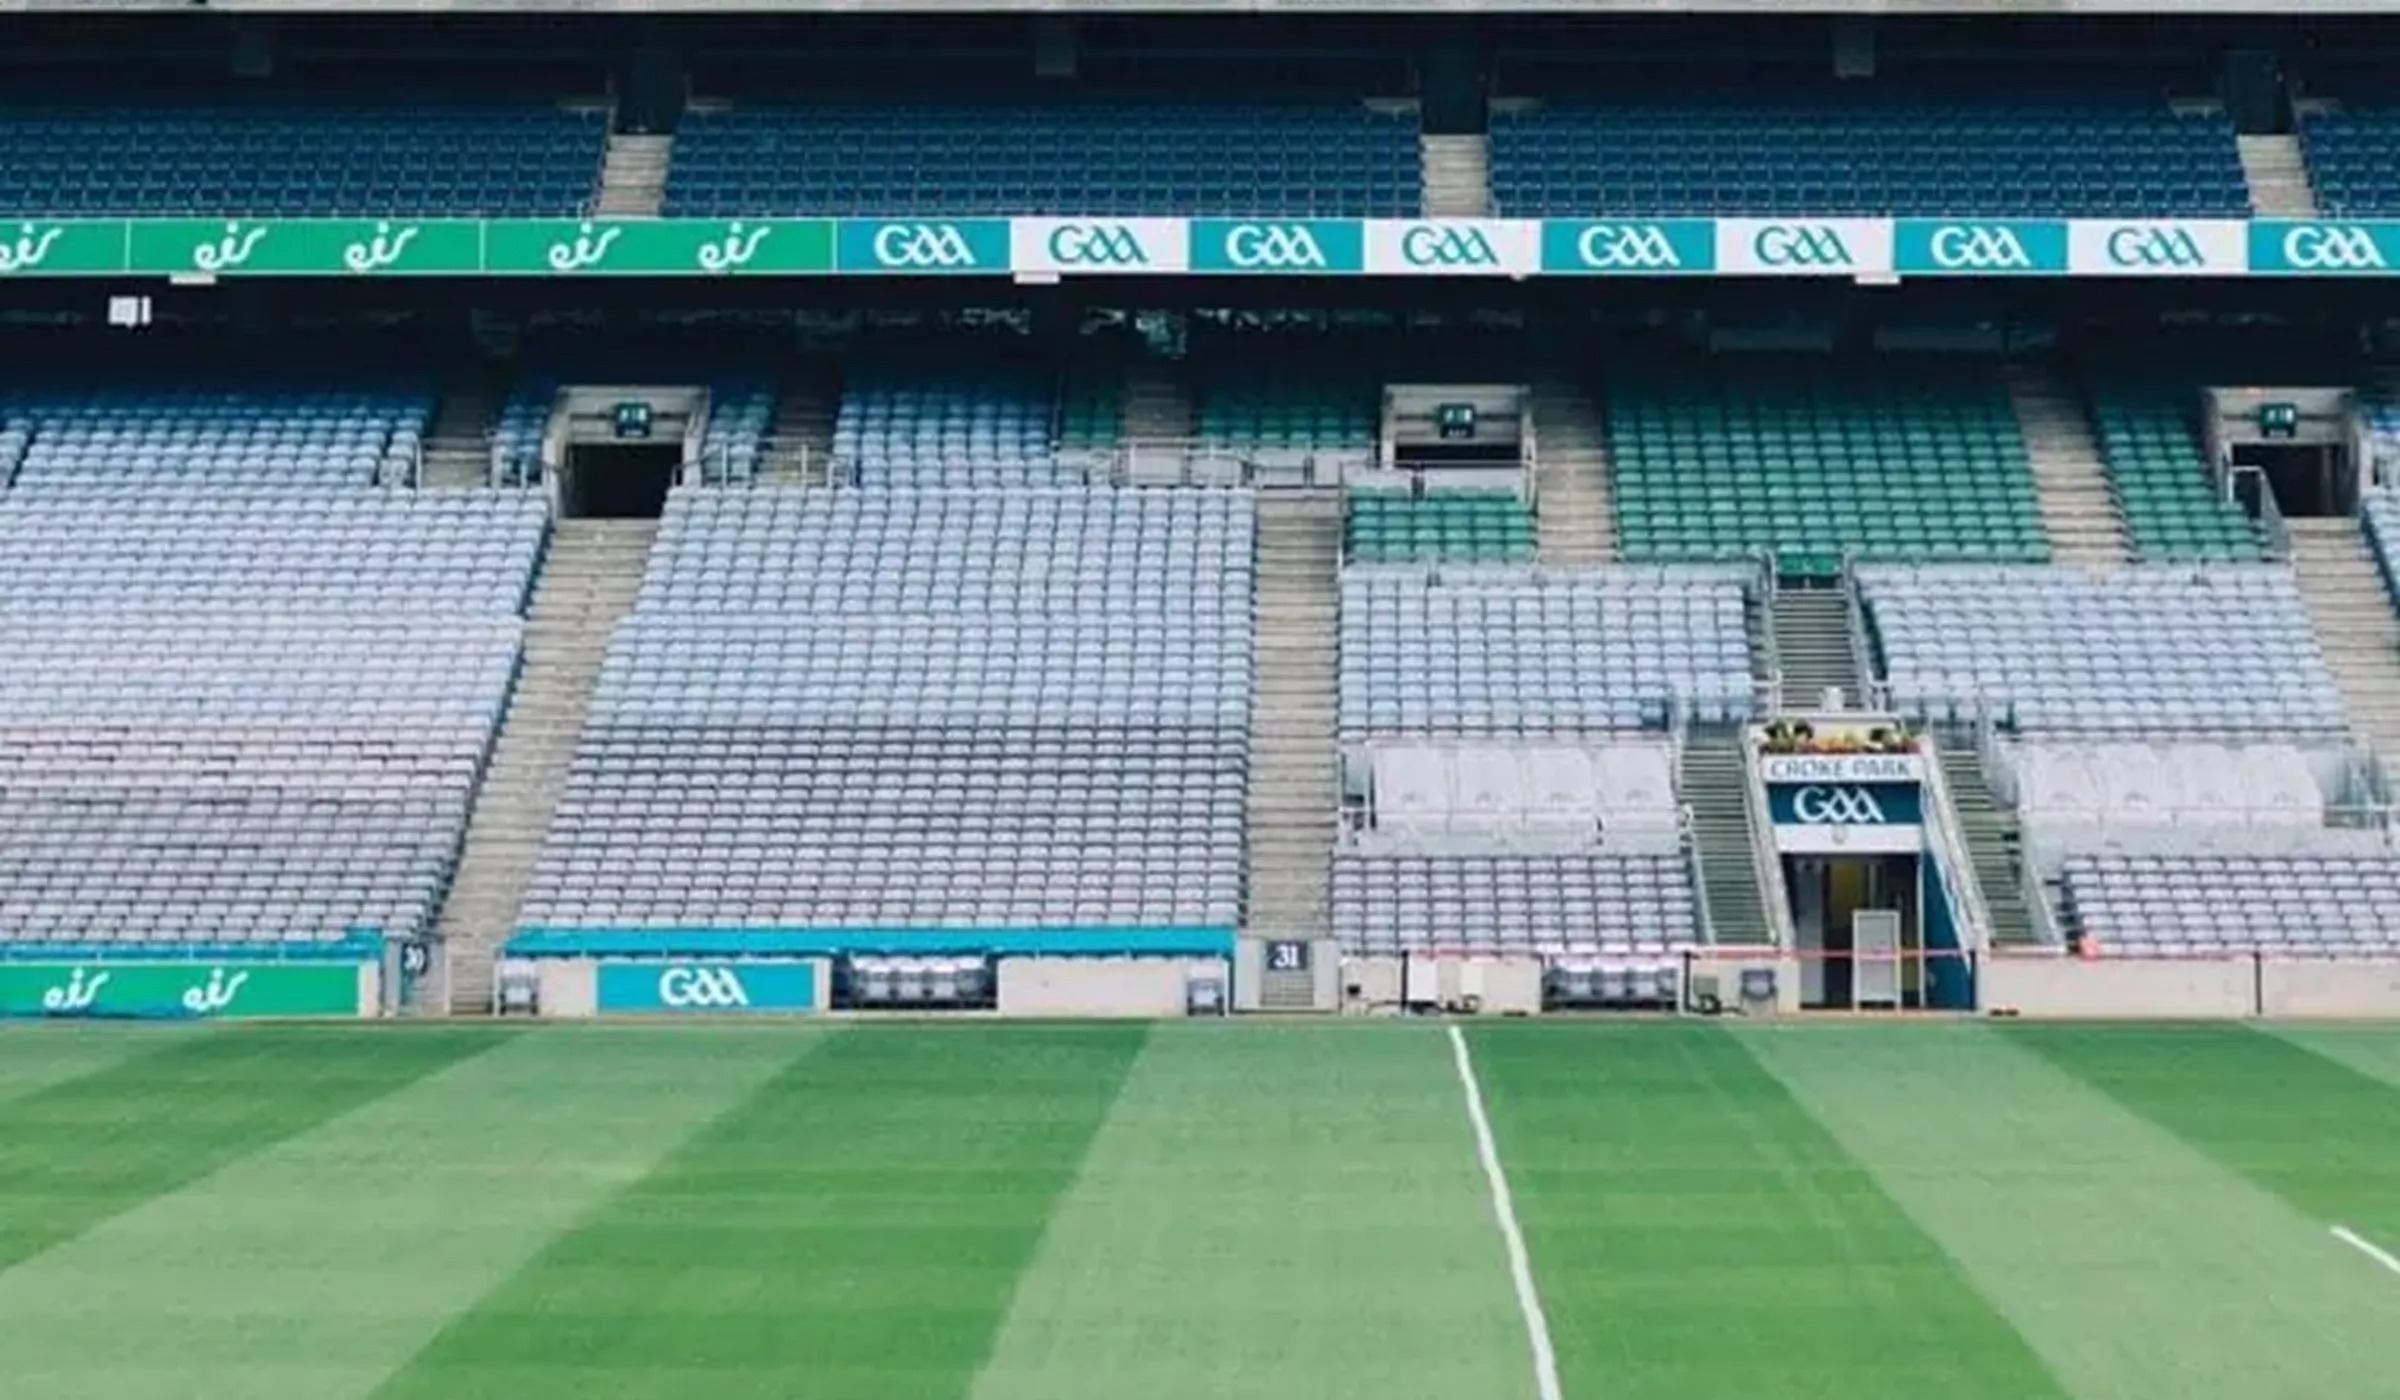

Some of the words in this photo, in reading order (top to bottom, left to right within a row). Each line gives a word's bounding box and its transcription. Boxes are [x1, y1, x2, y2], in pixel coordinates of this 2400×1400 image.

[194, 222, 266, 270] eir
[344, 222, 417, 270] eir
[548, 222, 620, 270] eir
[698, 222, 770, 270] eir
[874, 225, 975, 267] GAA
[1048, 225, 1148, 265] GAA
[1225, 225, 1326, 267] GAA
[1402, 226, 1500, 266] GAA
[1578, 225, 1680, 267] GAA
[1754, 226, 1853, 266] GAA
[1930, 226, 2031, 267] GAA
[2107, 226, 2205, 267] GAA
[2283, 226, 2387, 267] GAA
[1771, 760, 1842, 777] CROKE
[1853, 759, 1910, 777] PARK
[1793, 786, 1885, 822] GAA
[1274, 944, 1299, 968] 31
[44, 967, 109, 1010] eir
[183, 967, 248, 1012] eir
[659, 966, 749, 1006] GAA
